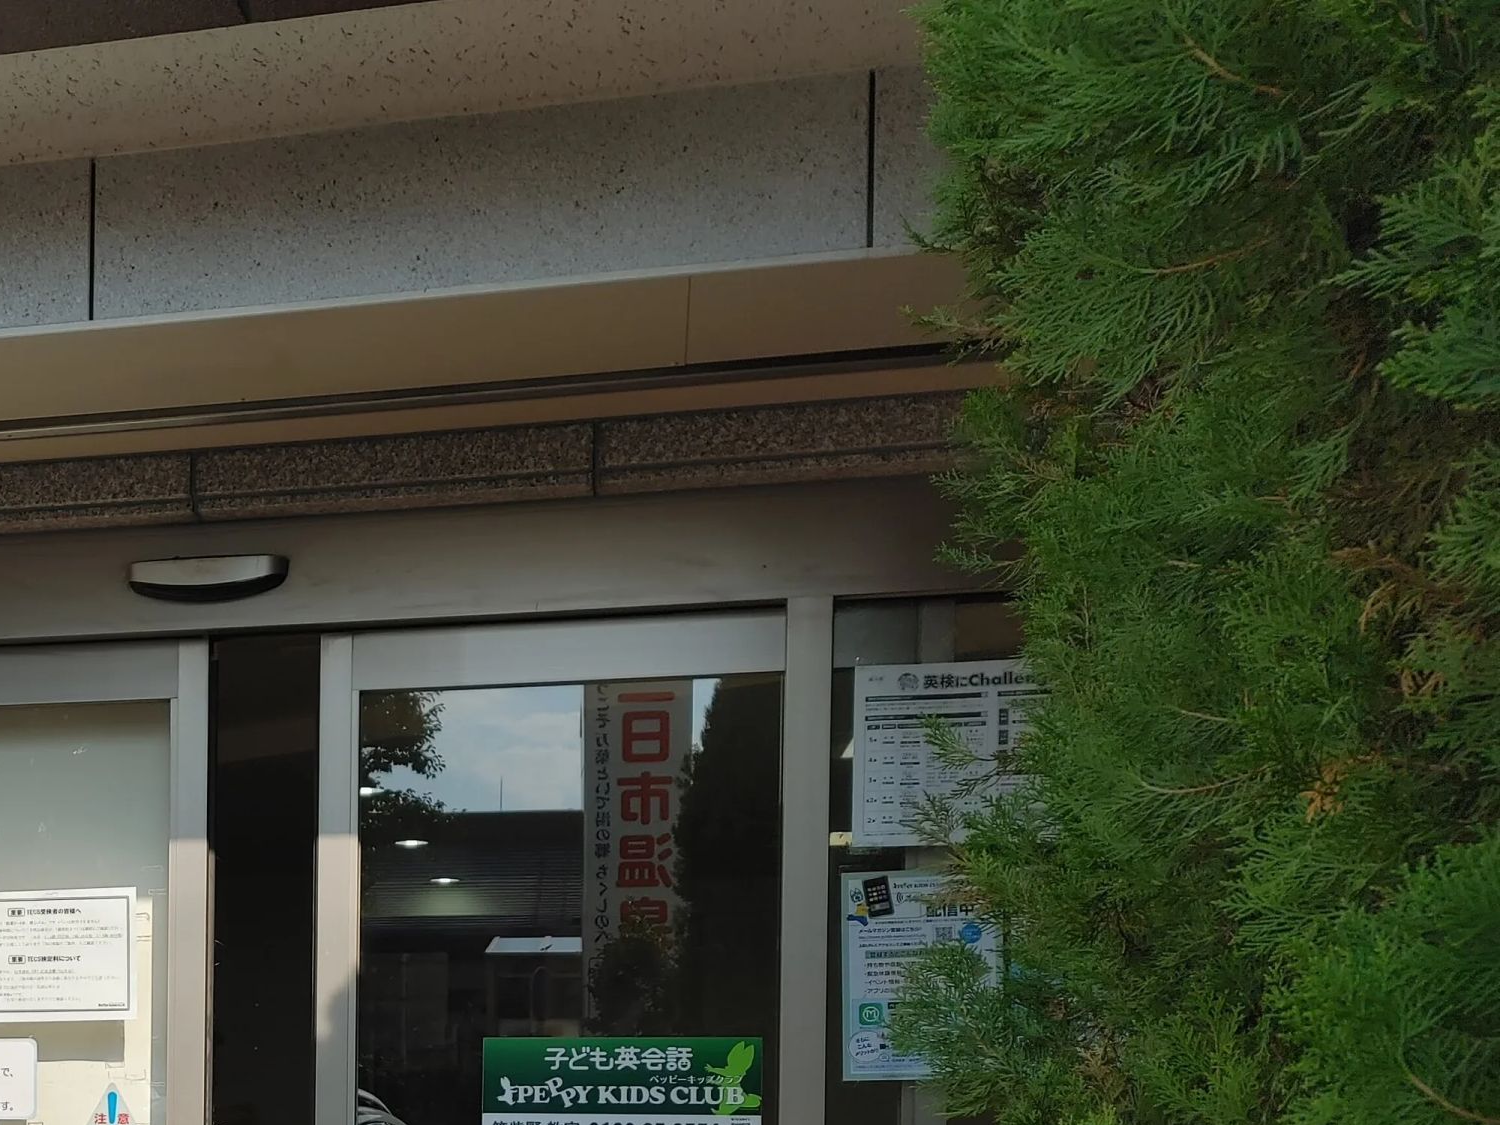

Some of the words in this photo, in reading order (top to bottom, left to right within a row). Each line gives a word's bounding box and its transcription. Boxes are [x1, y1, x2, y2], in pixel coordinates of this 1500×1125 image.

[544, 1046, 693, 1071] 子ども英会話
[598, 1084, 665, 1105] KIDS
[670, 1085, 746, 1105] CLUB
